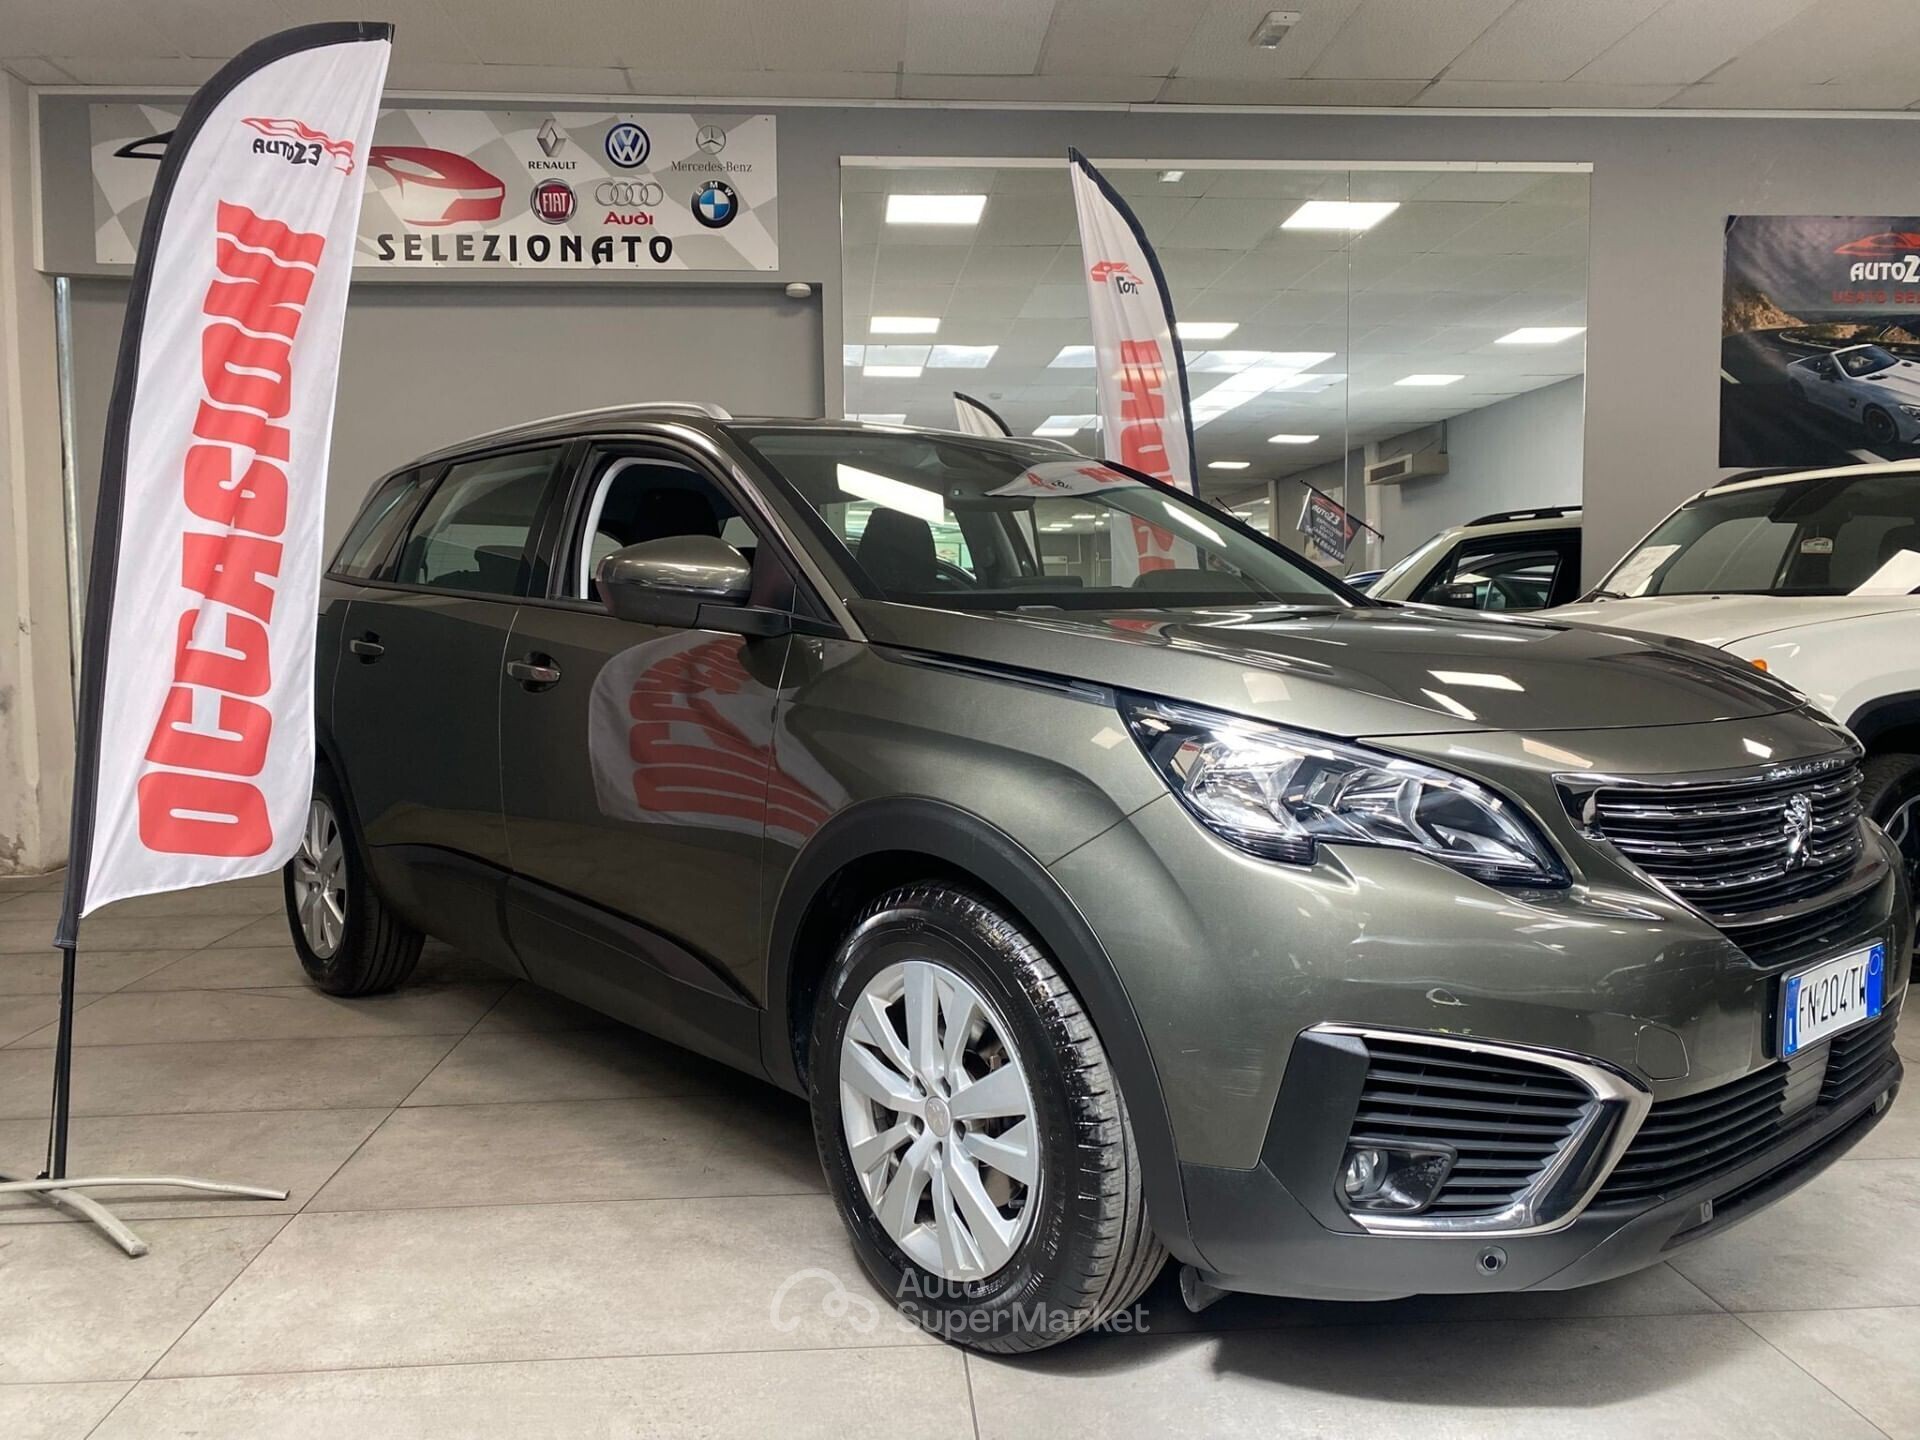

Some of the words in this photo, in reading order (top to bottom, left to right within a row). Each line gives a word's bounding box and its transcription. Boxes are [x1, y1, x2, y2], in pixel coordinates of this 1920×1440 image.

[528, 160, 577, 170] RENAULT
[671, 160, 753, 173] Mercedes-Benz
[542, 192, 569, 213] FIAT
[603, 211, 654, 226] Audi
[377, 234, 674, 265] SELEZIONATO
